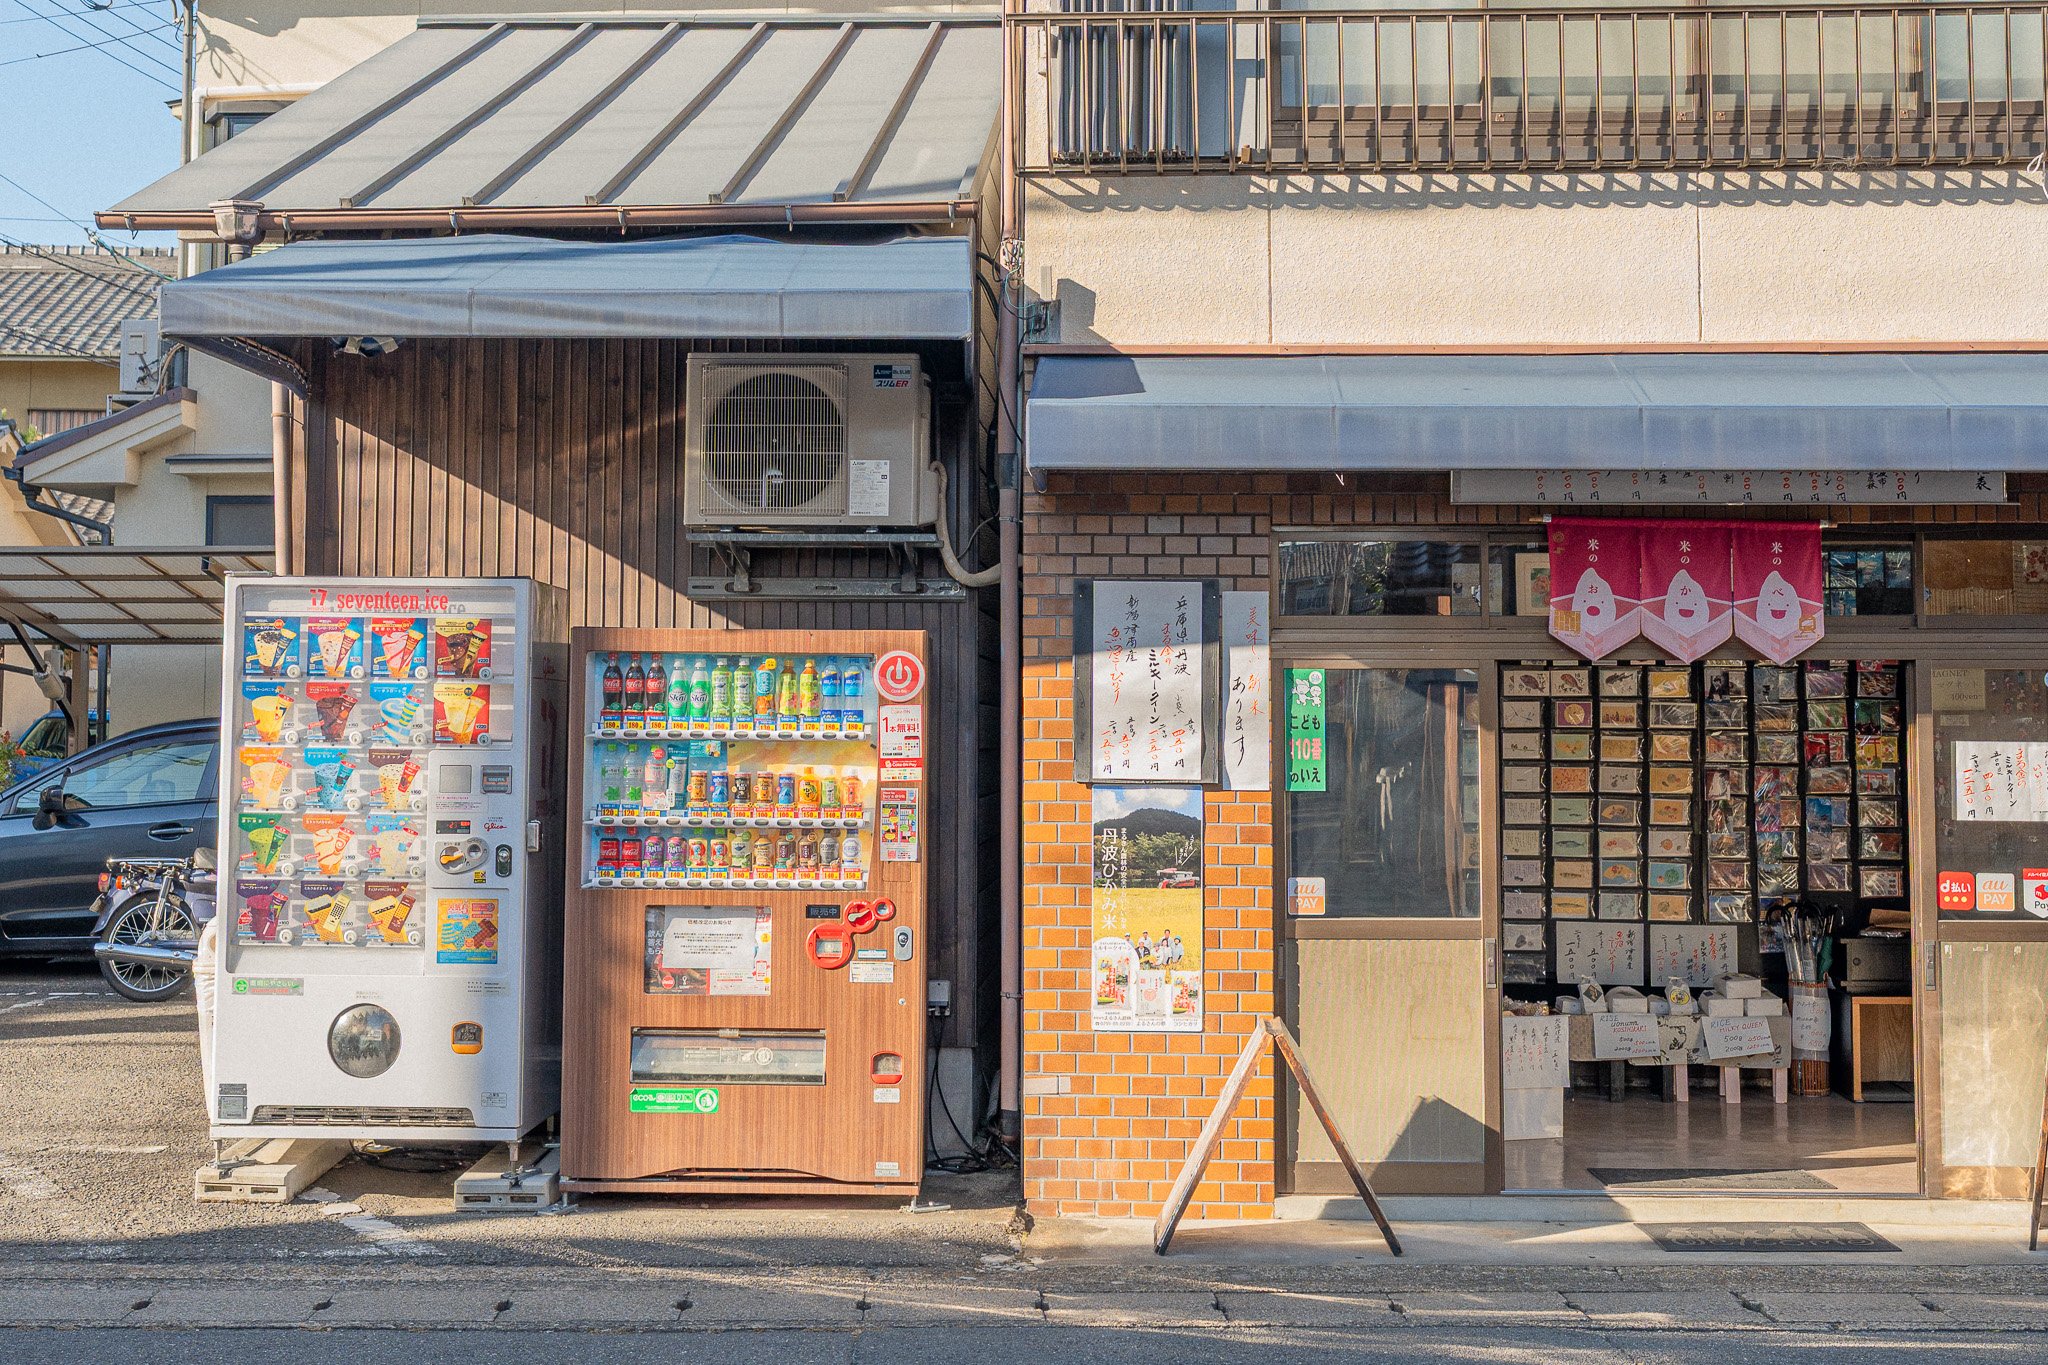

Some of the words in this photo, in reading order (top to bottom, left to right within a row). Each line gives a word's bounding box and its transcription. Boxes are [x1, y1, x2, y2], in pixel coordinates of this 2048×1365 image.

[1680, 586, 1692, 596] か
[336, 591, 419, 610] seventeen
[424, 588, 448, 610] ice
[1149, 649, 1162, 724] ミルキークイーン
[1232, 676, 1246, 768] あります
[1290, 714, 1320, 730] こども
[1290, 737, 1322, 760] 110番
[1290, 768, 1320, 783] のいえ
[2006, 756, 2018, 807] ミルキークイーン
[484, 823, 507, 832] Glico
[1102, 828, 1118, 930] 丹波ひかみ米
[1294, 884, 1319, 895] au
[1940, 880, 1971, 893] d払い
[1982, 880, 2008, 891] au
[1296, 898, 1318, 910] PAY
[1984, 894, 2008, 905] PAY
[810, 907, 838, 916] 販売中
[1711, 1019, 1730, 1029] RICE
[1720, 1024, 1740, 1033] MILKY
[1742, 1021, 1764, 1030] QUEEN
